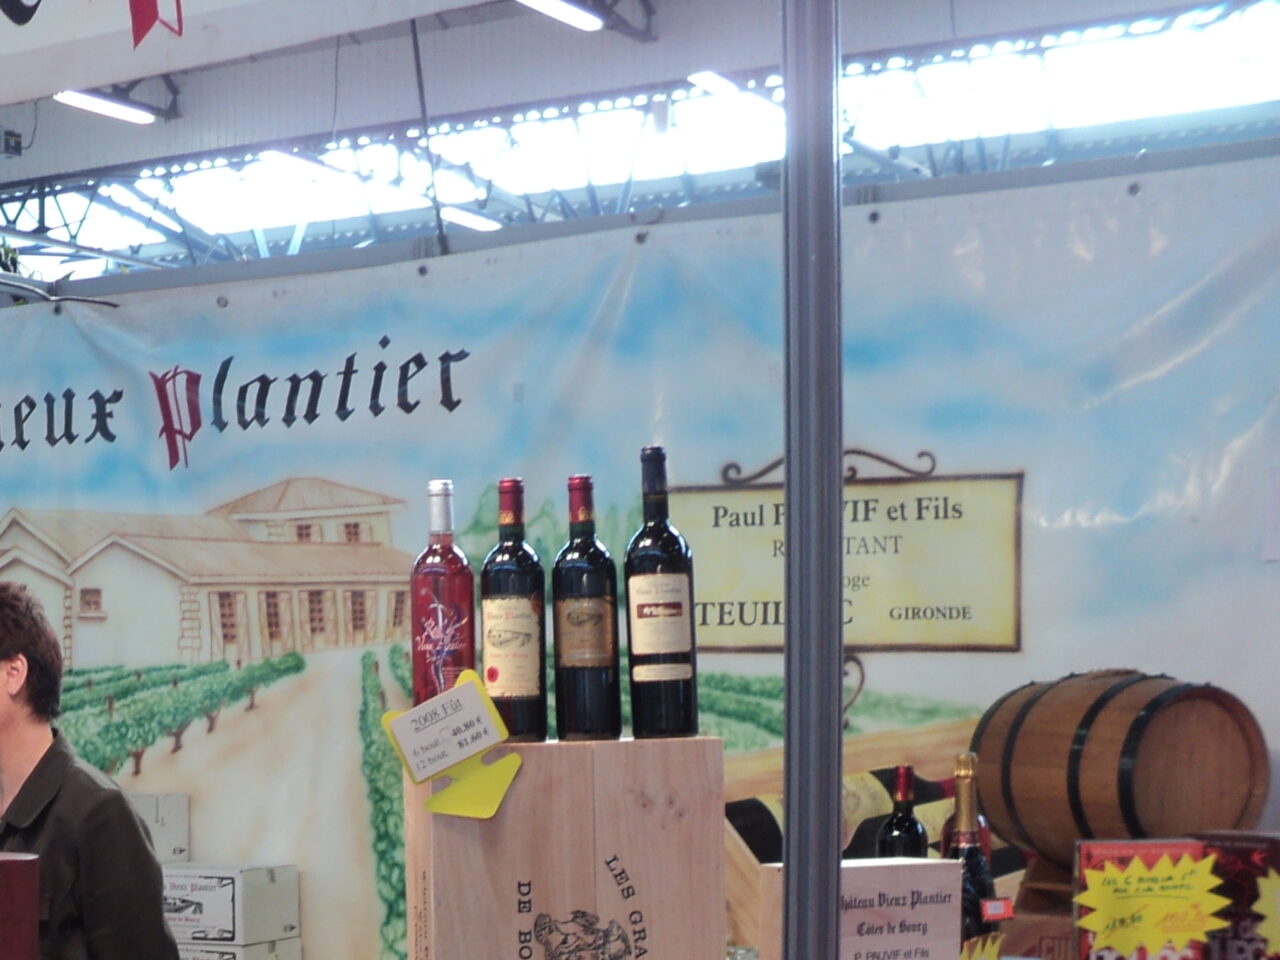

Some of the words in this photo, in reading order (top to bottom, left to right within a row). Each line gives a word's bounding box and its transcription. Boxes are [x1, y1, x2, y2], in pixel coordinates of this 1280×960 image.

[148, 334, 471, 471] Plantier
[712, 504, 764, 528] Paul
[886, 502, 908, 521] et
[915, 496, 964, 521] Fils
[889, 606, 973, 621] GIRONDE
[604, 854, 636, 901] LES
[517, 881, 532, 913] DE
